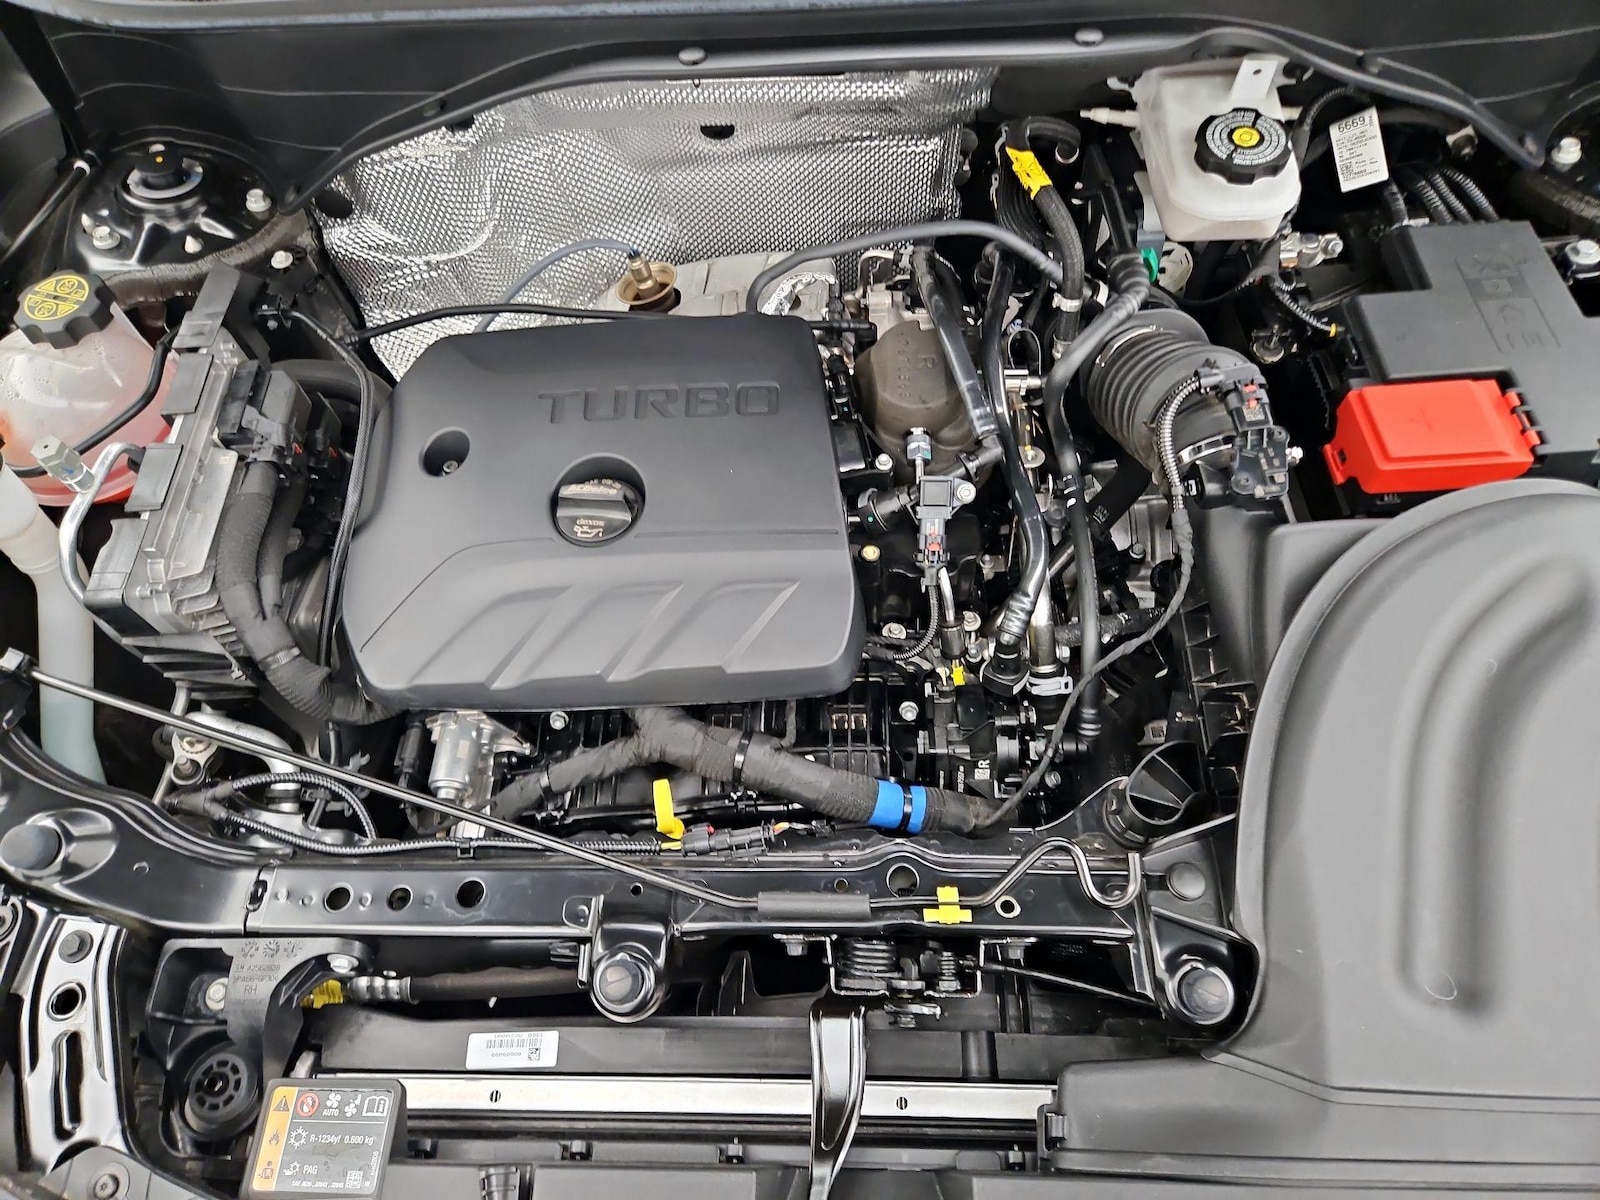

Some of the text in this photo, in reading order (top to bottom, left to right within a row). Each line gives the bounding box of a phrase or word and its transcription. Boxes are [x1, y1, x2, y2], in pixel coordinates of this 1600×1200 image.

[1337, 115, 1366, 133] 6669
[538, 381, 780, 424] TURBO
[576, 518, 605, 527] dexos
[977, 759, 990, 769] R
[243, 984, 258, 996] RH
[322, 1108, 340, 1117] AUTO
[309, 1134, 374, 1146] R-1234yf 0.600 kg
[302, 1164, 318, 1175] PAG
